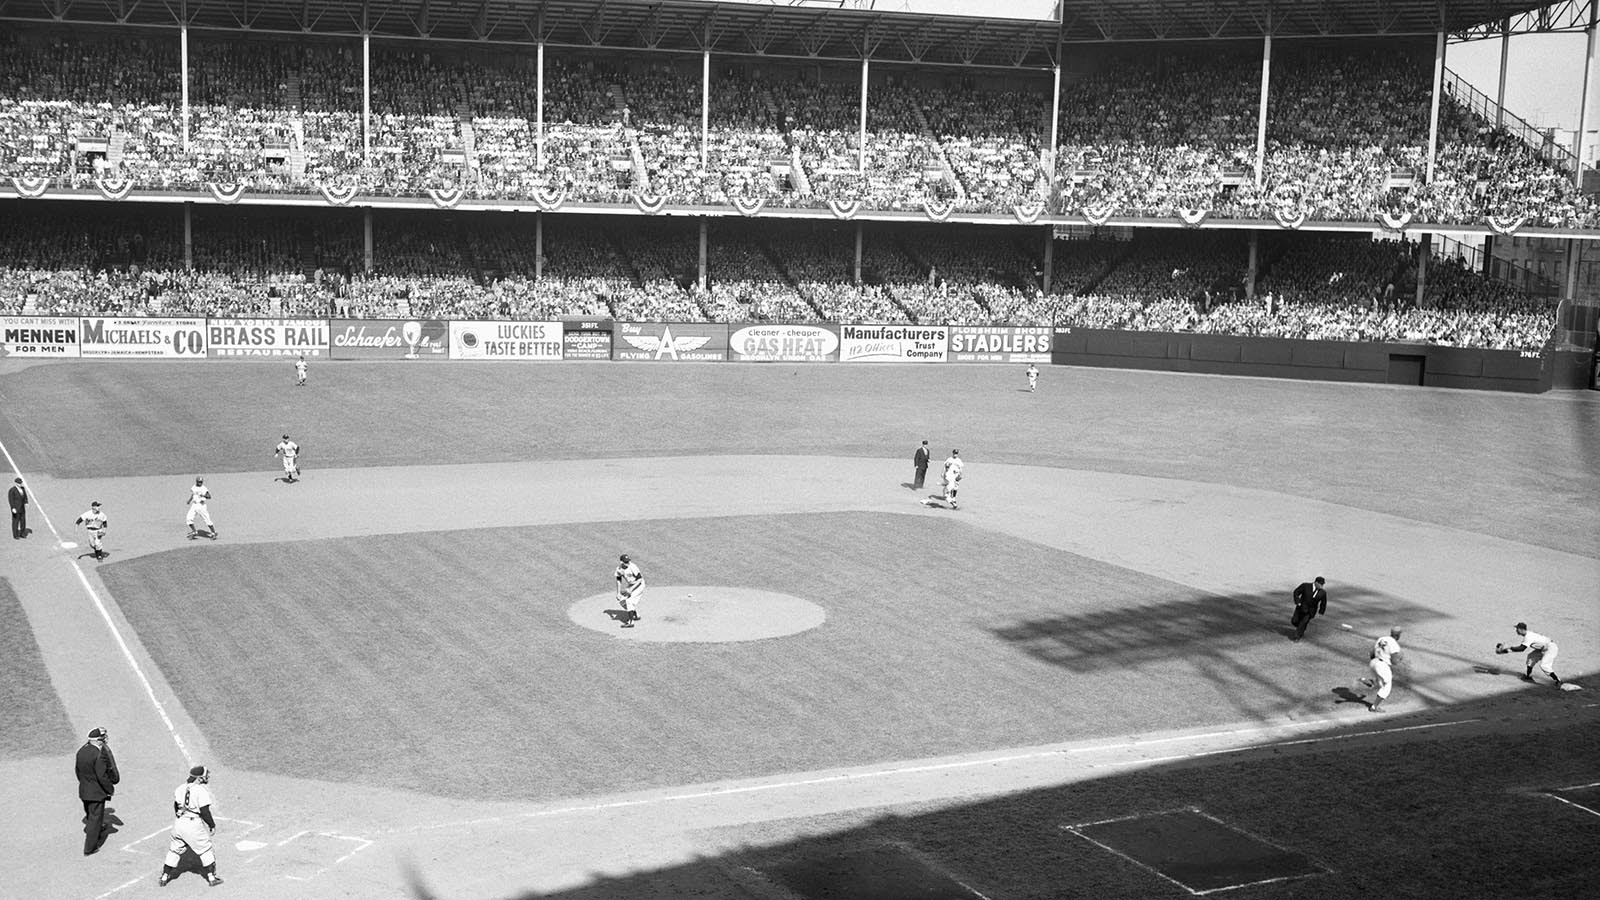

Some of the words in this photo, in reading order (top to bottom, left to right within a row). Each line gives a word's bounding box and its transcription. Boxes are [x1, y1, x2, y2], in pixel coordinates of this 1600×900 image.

[59, 318, 75, 326] WITH
[621, 323, 642, 335] Buy
[5, 328, 76, 343] MENNEN
[210, 327, 276, 345] BRASS
[284, 327, 328, 346] RAIL
[334, 325, 402, 348] Schaefer
[498, 324, 546, 339] LUCKIES
[787, 329, 821, 337] cheaper
[844, 326, 945, 340] Manufacturers
[164, 335, 171, 344] &
[173, 330, 205, 354] CO.
[484, 341, 516, 356] TASTE
[519, 341, 561, 356] BETTER
[654, 325, 679, 360] A
[743, 337, 779, 356] GAS
[782, 338, 826, 356] HEAT
[914, 341, 936, 349] Trust
[951, 334, 1049, 352] STADLERS
[849, 345, 863, 356] 112
[906, 349, 944, 359] Company
[185, 790, 190, 806] 8
